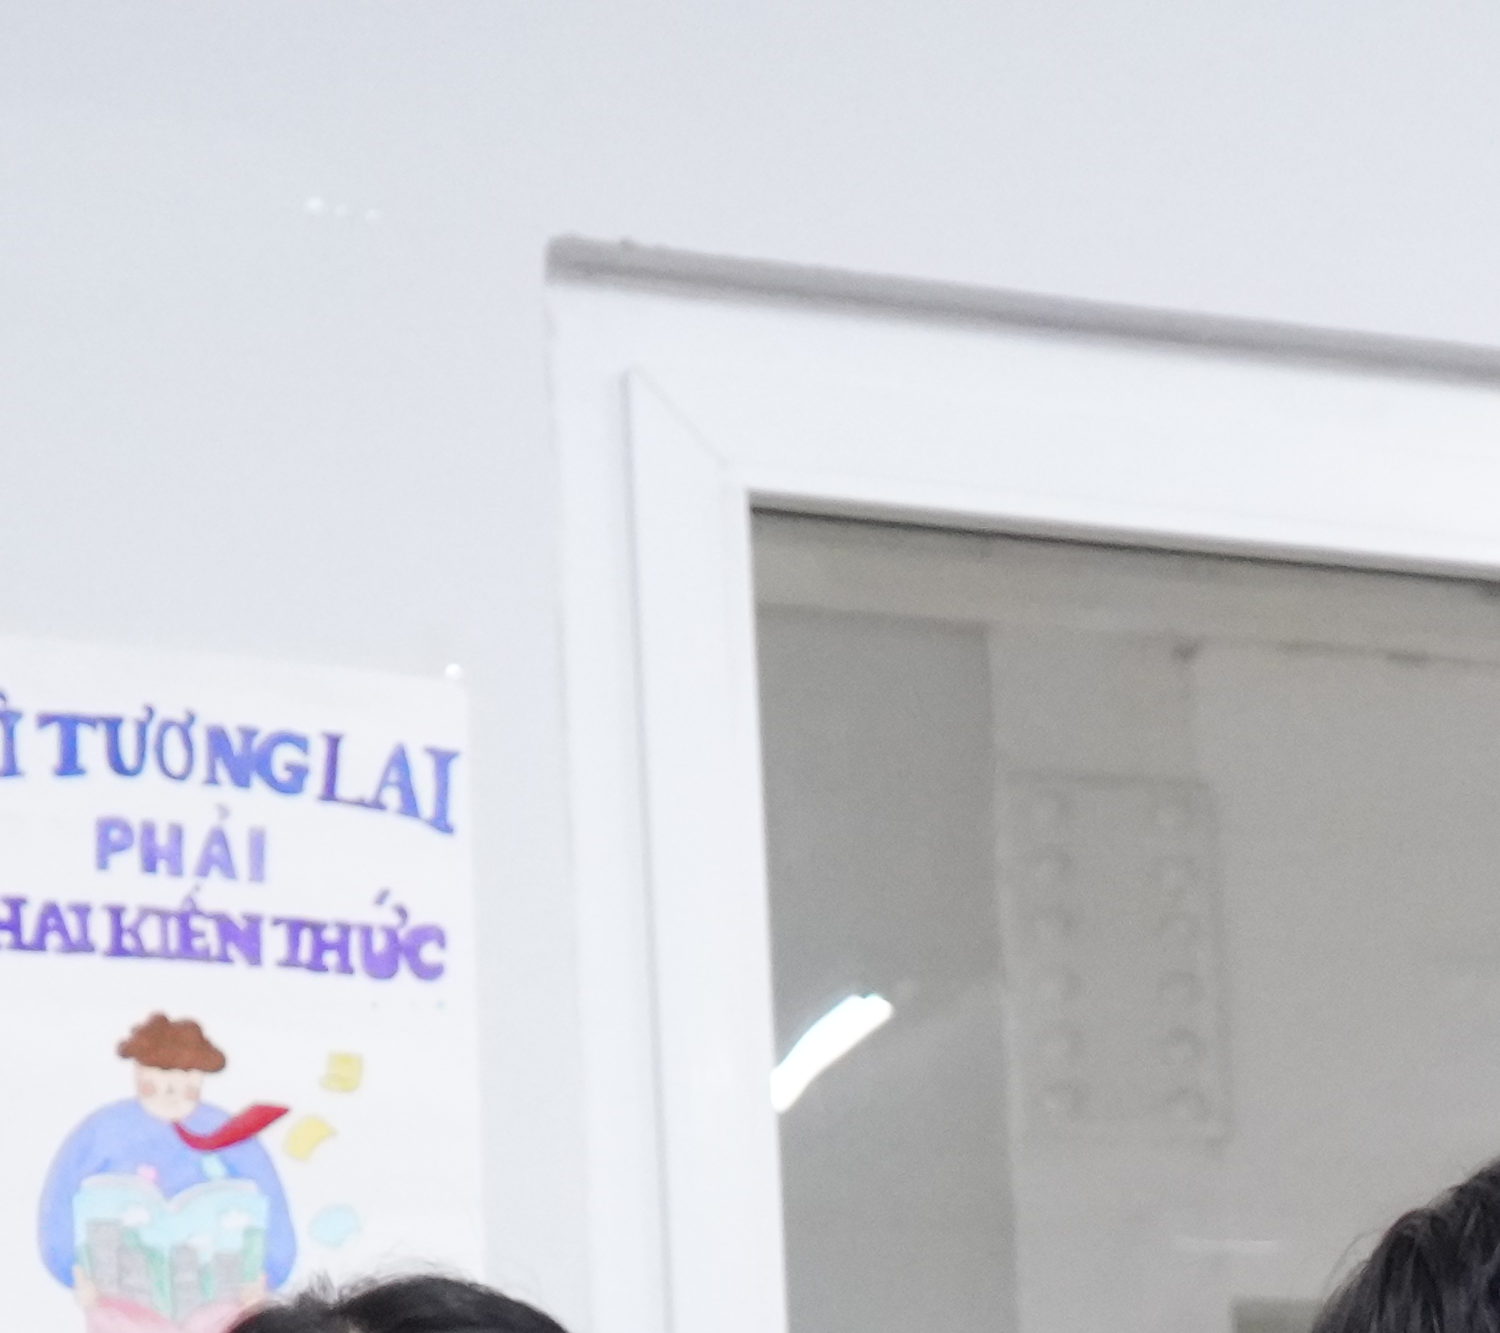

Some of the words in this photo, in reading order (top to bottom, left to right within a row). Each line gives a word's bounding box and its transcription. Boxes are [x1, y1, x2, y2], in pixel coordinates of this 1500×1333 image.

[37, 706, 310, 795] TƯƠNG
[317, 733, 459, 834] LAI
[97, 807, 268, 882] PHẢI
[273, 890, 447, 981] THỨC
